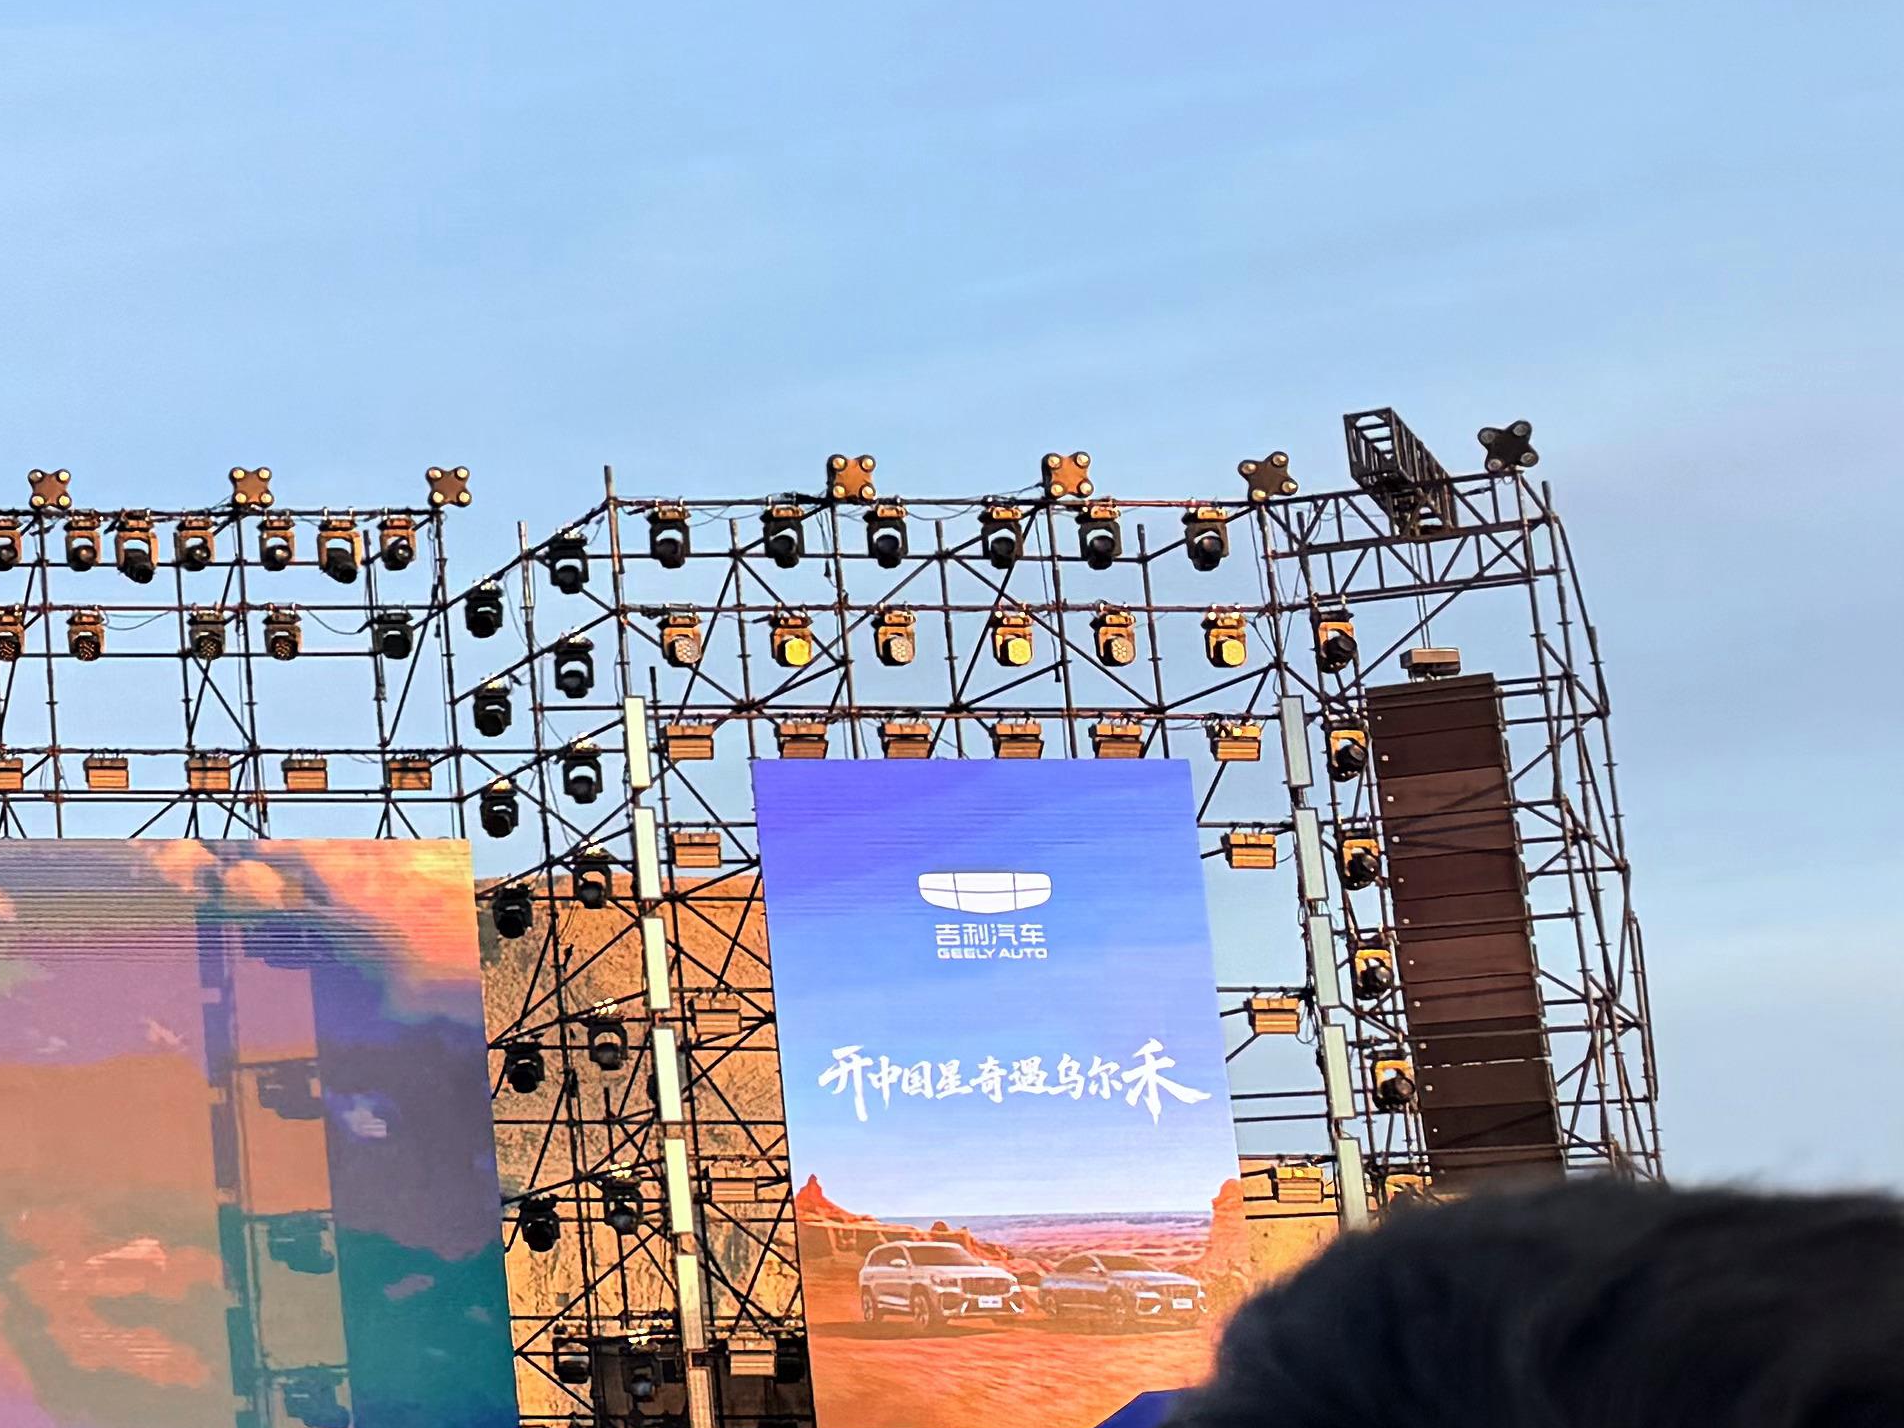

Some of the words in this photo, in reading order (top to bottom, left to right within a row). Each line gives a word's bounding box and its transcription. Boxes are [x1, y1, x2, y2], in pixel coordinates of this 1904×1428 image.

[935, 923, 1047, 946] 吉利汽车
[937, 947, 996, 960] GEELY
[998, 947, 1048, 960] AUTO
[818, 1036, 1213, 1126] 开中国星奇遇乌尔禾
